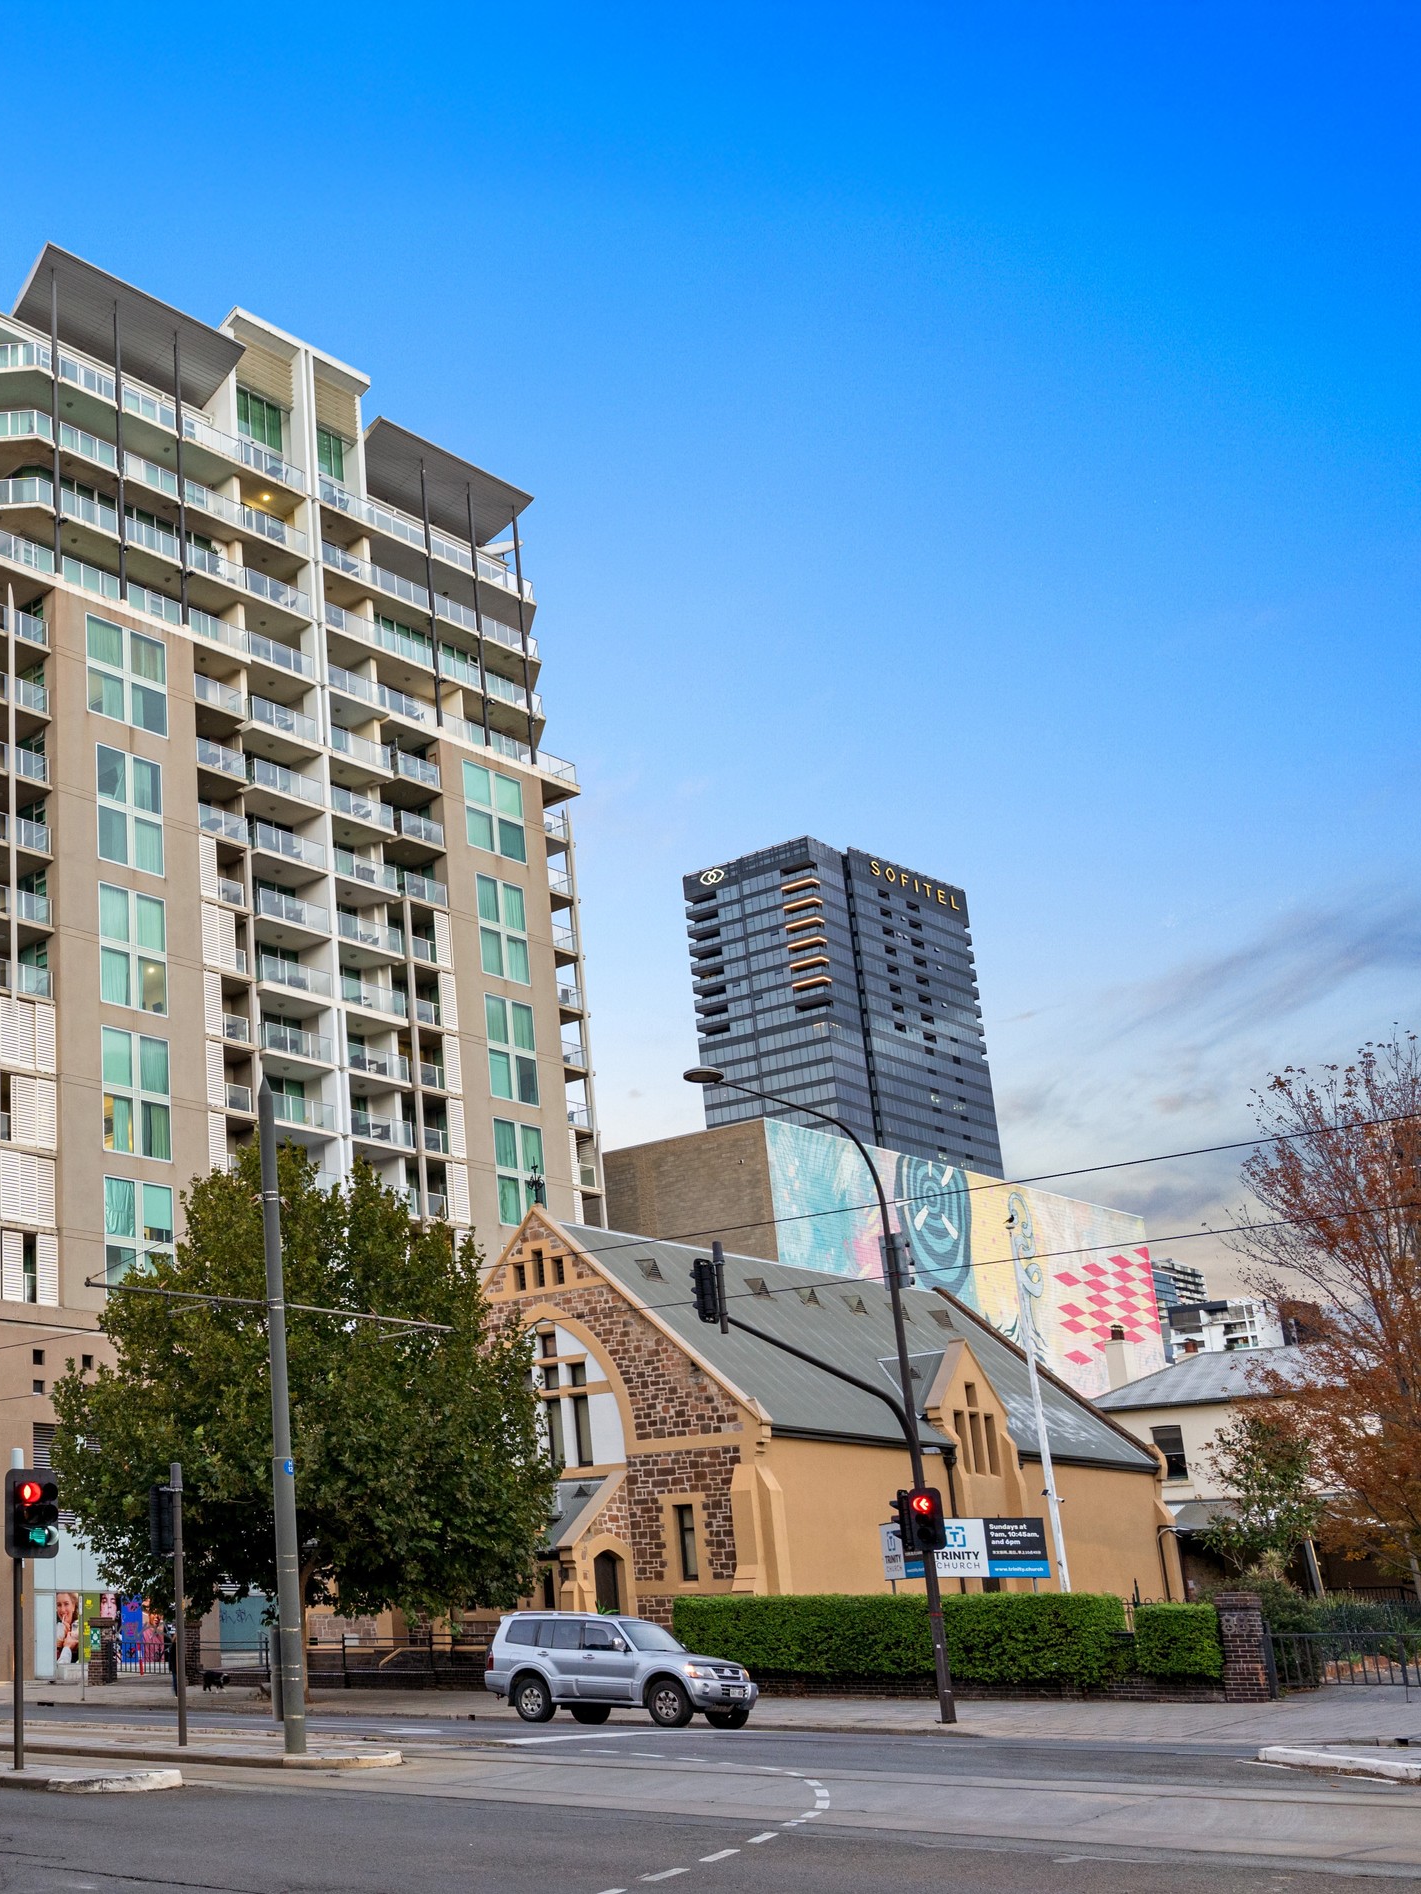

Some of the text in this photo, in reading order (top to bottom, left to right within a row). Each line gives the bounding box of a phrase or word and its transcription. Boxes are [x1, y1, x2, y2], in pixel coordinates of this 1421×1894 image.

[870, 861, 960, 911] SOFITEL
[1005, 1538, 1021, 1546] 6pm
[934, 1551, 979, 1560] TRINITY
